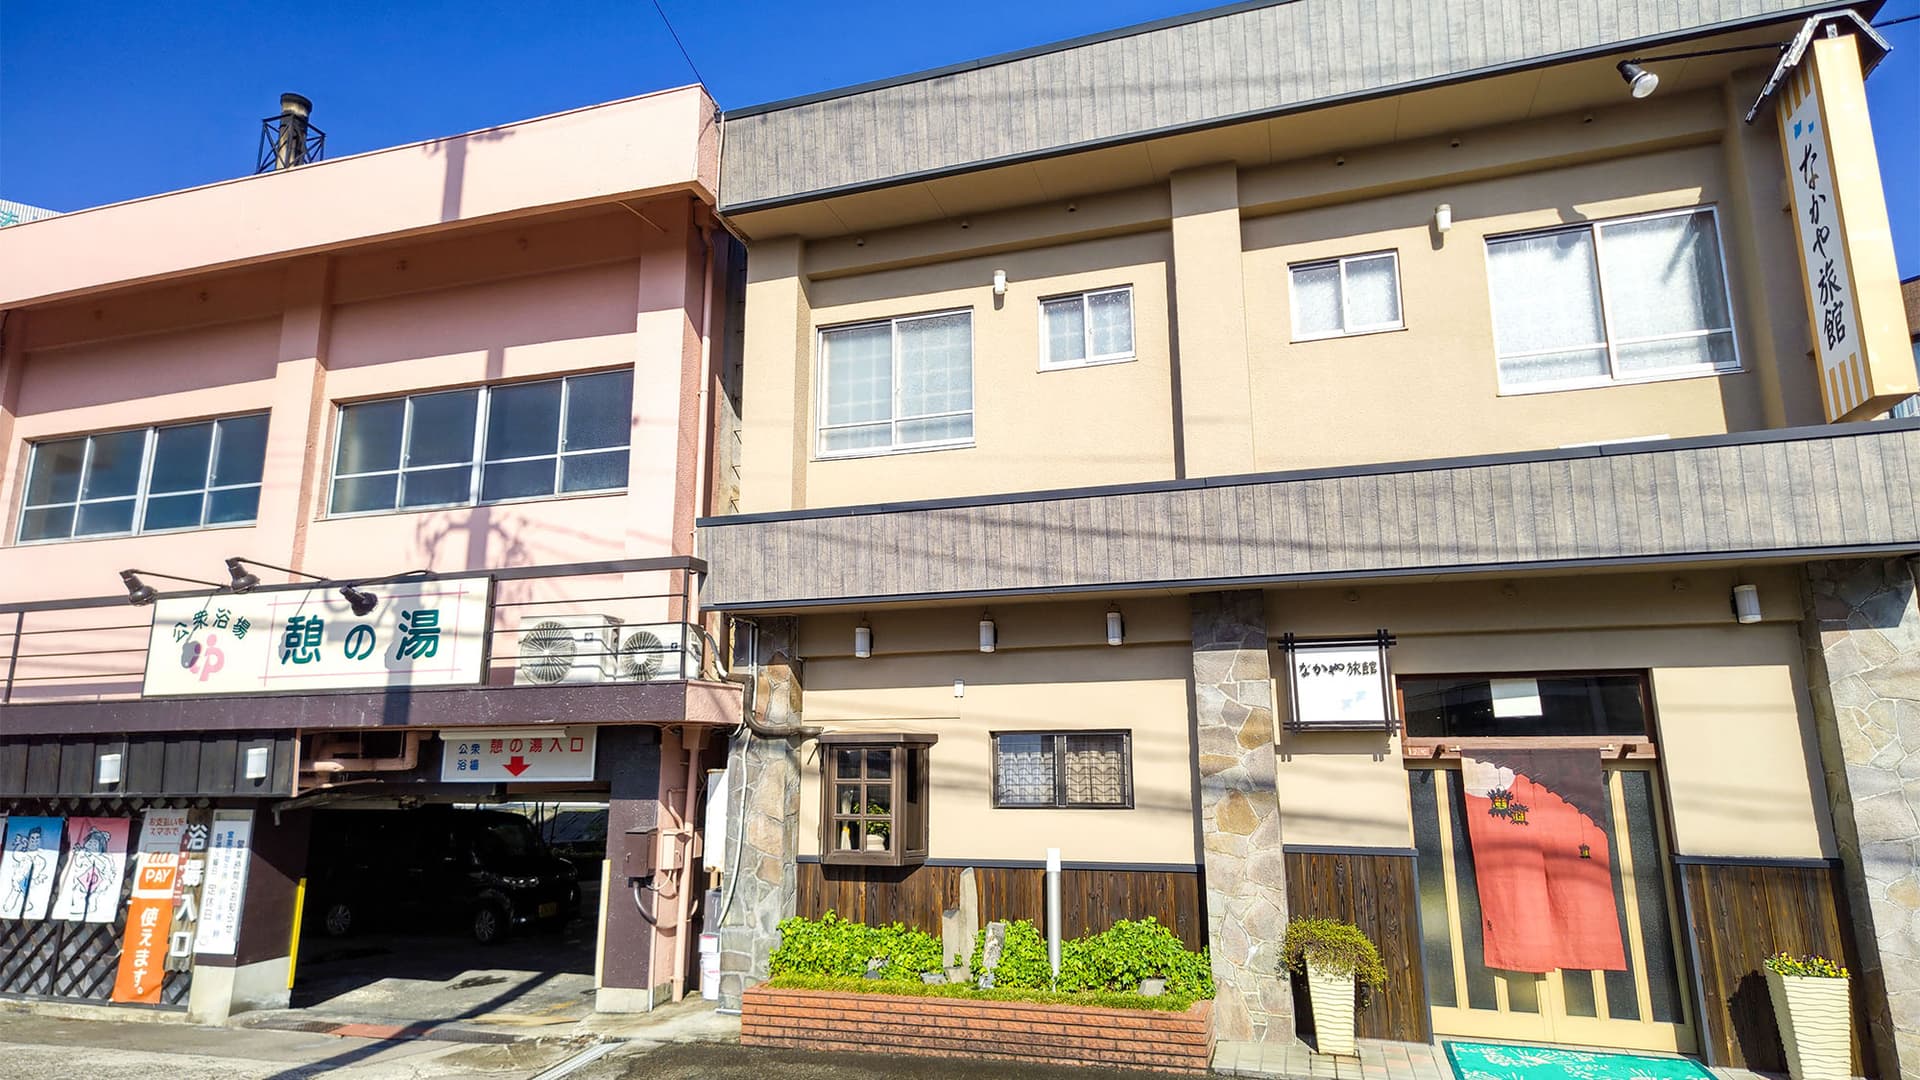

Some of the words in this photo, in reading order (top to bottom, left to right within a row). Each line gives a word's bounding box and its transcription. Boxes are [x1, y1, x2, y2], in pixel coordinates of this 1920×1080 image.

[1799, 144, 1847, 351] なかや旅館
[172, 608, 251, 643] 公衆浴場
[281, 608, 441, 666] 憩の湯
[1298, 660, 1378, 678] なかや旅館
[458, 743, 481, 755] 公衆
[489, 737, 584, 754] 憩の湯入口
[457, 759, 480, 771] 浴場
[149, 827, 180, 836] スマホで
[145, 868, 173, 883] PAY
[131, 906, 161, 995] 使えます。
